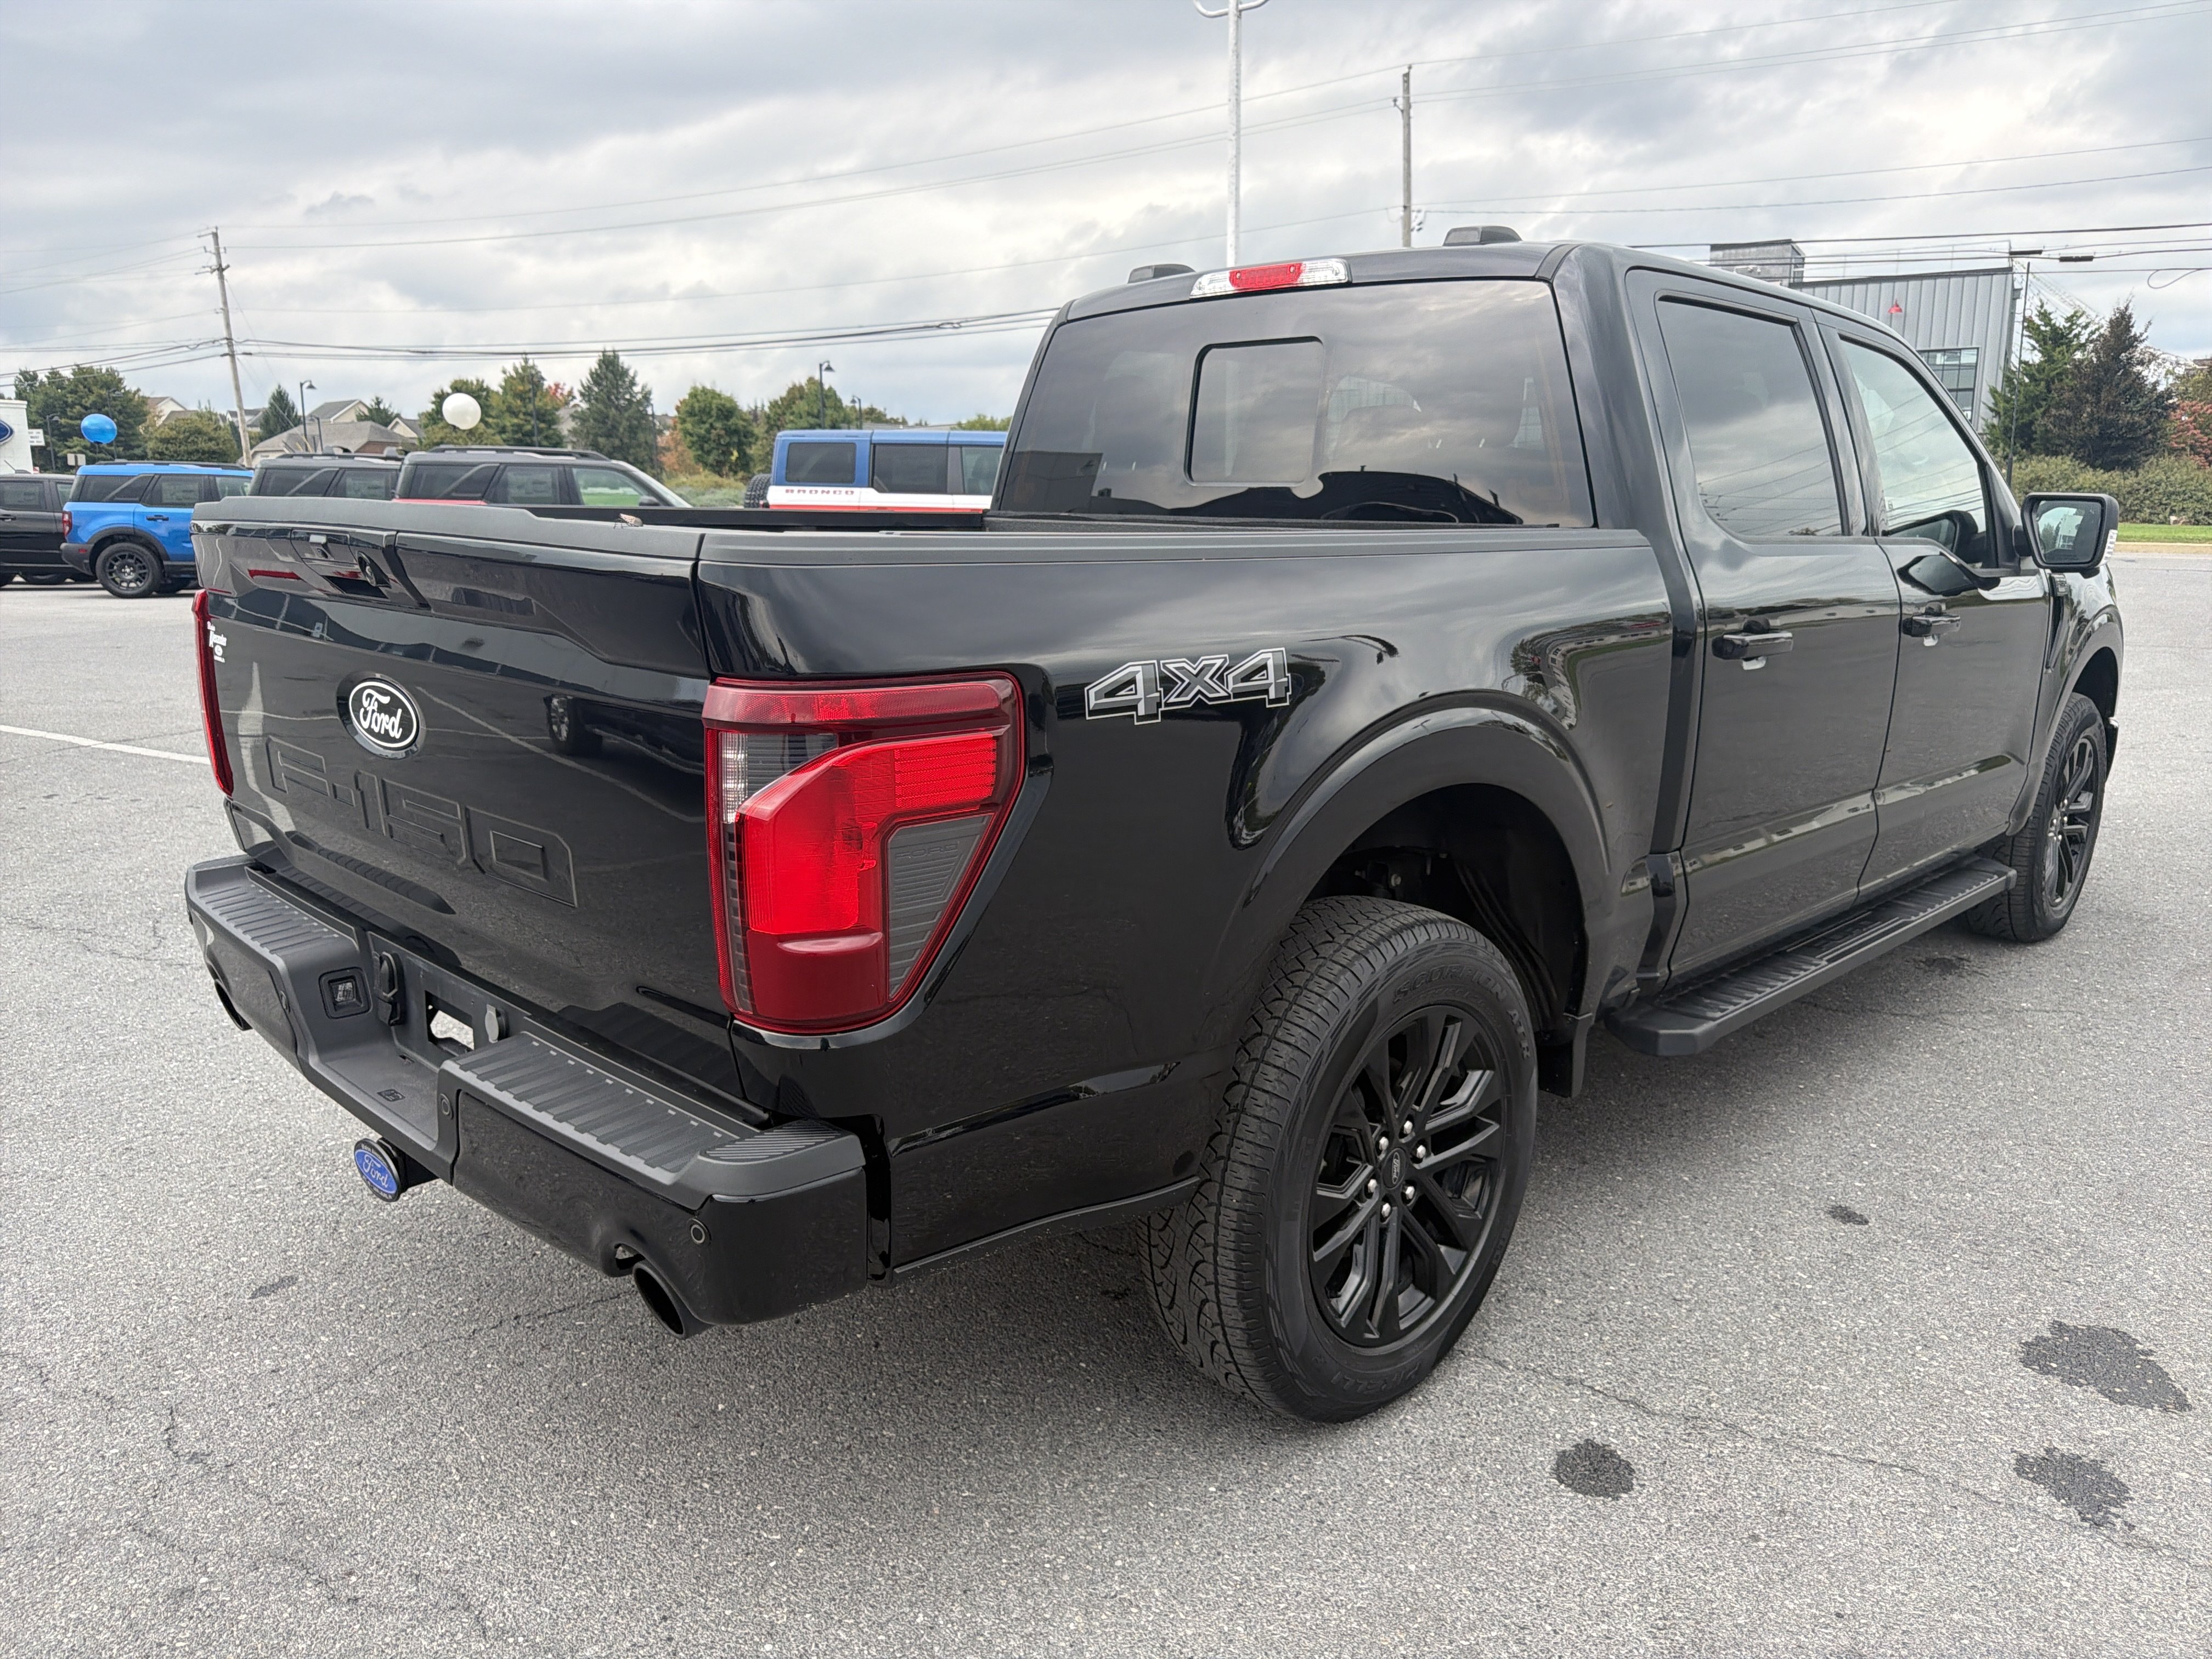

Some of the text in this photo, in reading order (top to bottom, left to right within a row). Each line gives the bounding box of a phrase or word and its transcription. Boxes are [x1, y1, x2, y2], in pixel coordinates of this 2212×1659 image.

[360, 689, 403, 739] Ford
[266, 736, 578, 908] F-150
[895, 843, 958, 860] FORD
[1392, 963, 1508, 1005] SCORPION
[363, 1154, 388, 1188] Ford
